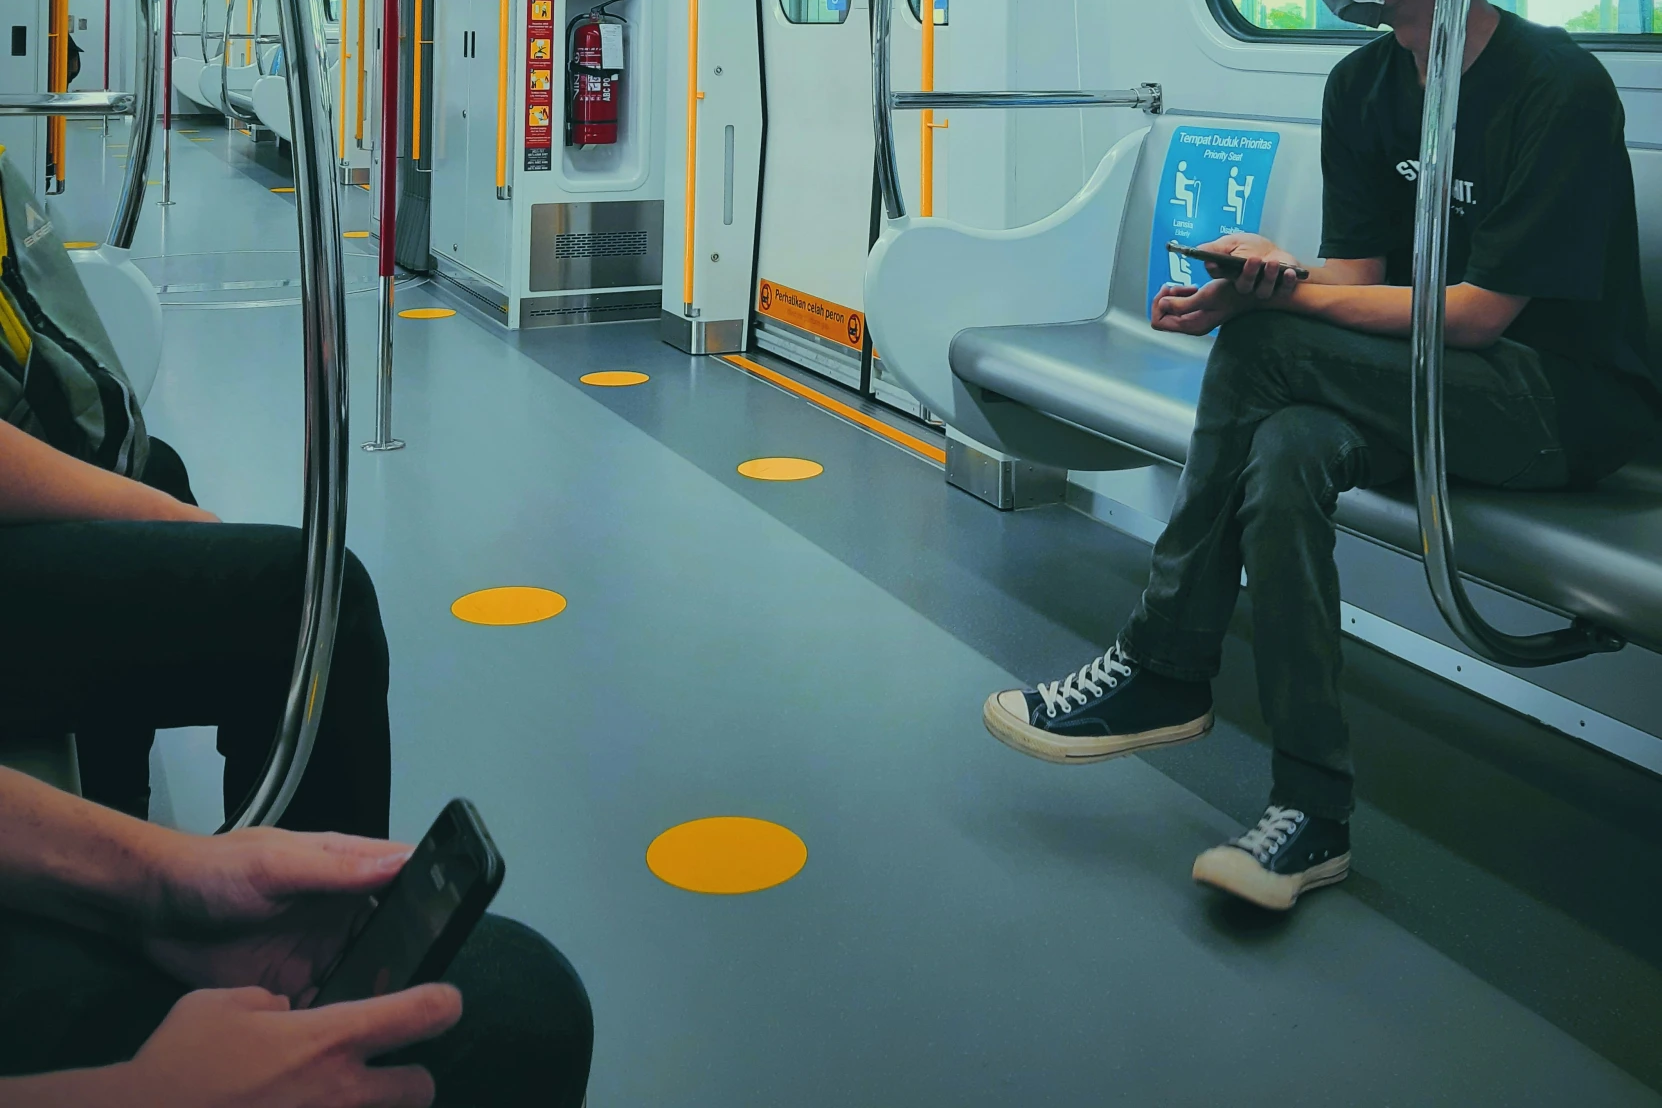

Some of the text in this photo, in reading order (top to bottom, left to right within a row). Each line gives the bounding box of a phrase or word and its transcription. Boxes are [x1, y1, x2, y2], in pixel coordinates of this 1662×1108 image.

[1180, 132, 1272, 150] Tempat Duduk Prioritas
[1204, 149, 1243, 162] Priority Seat
[1173, 219, 1194, 229] Lansia
[1174, 229, 1191, 238] Elderly
[775, 289, 806, 310] Perhatikan
[807, 302, 825, 317] celah
[825, 309, 844, 323] peron
